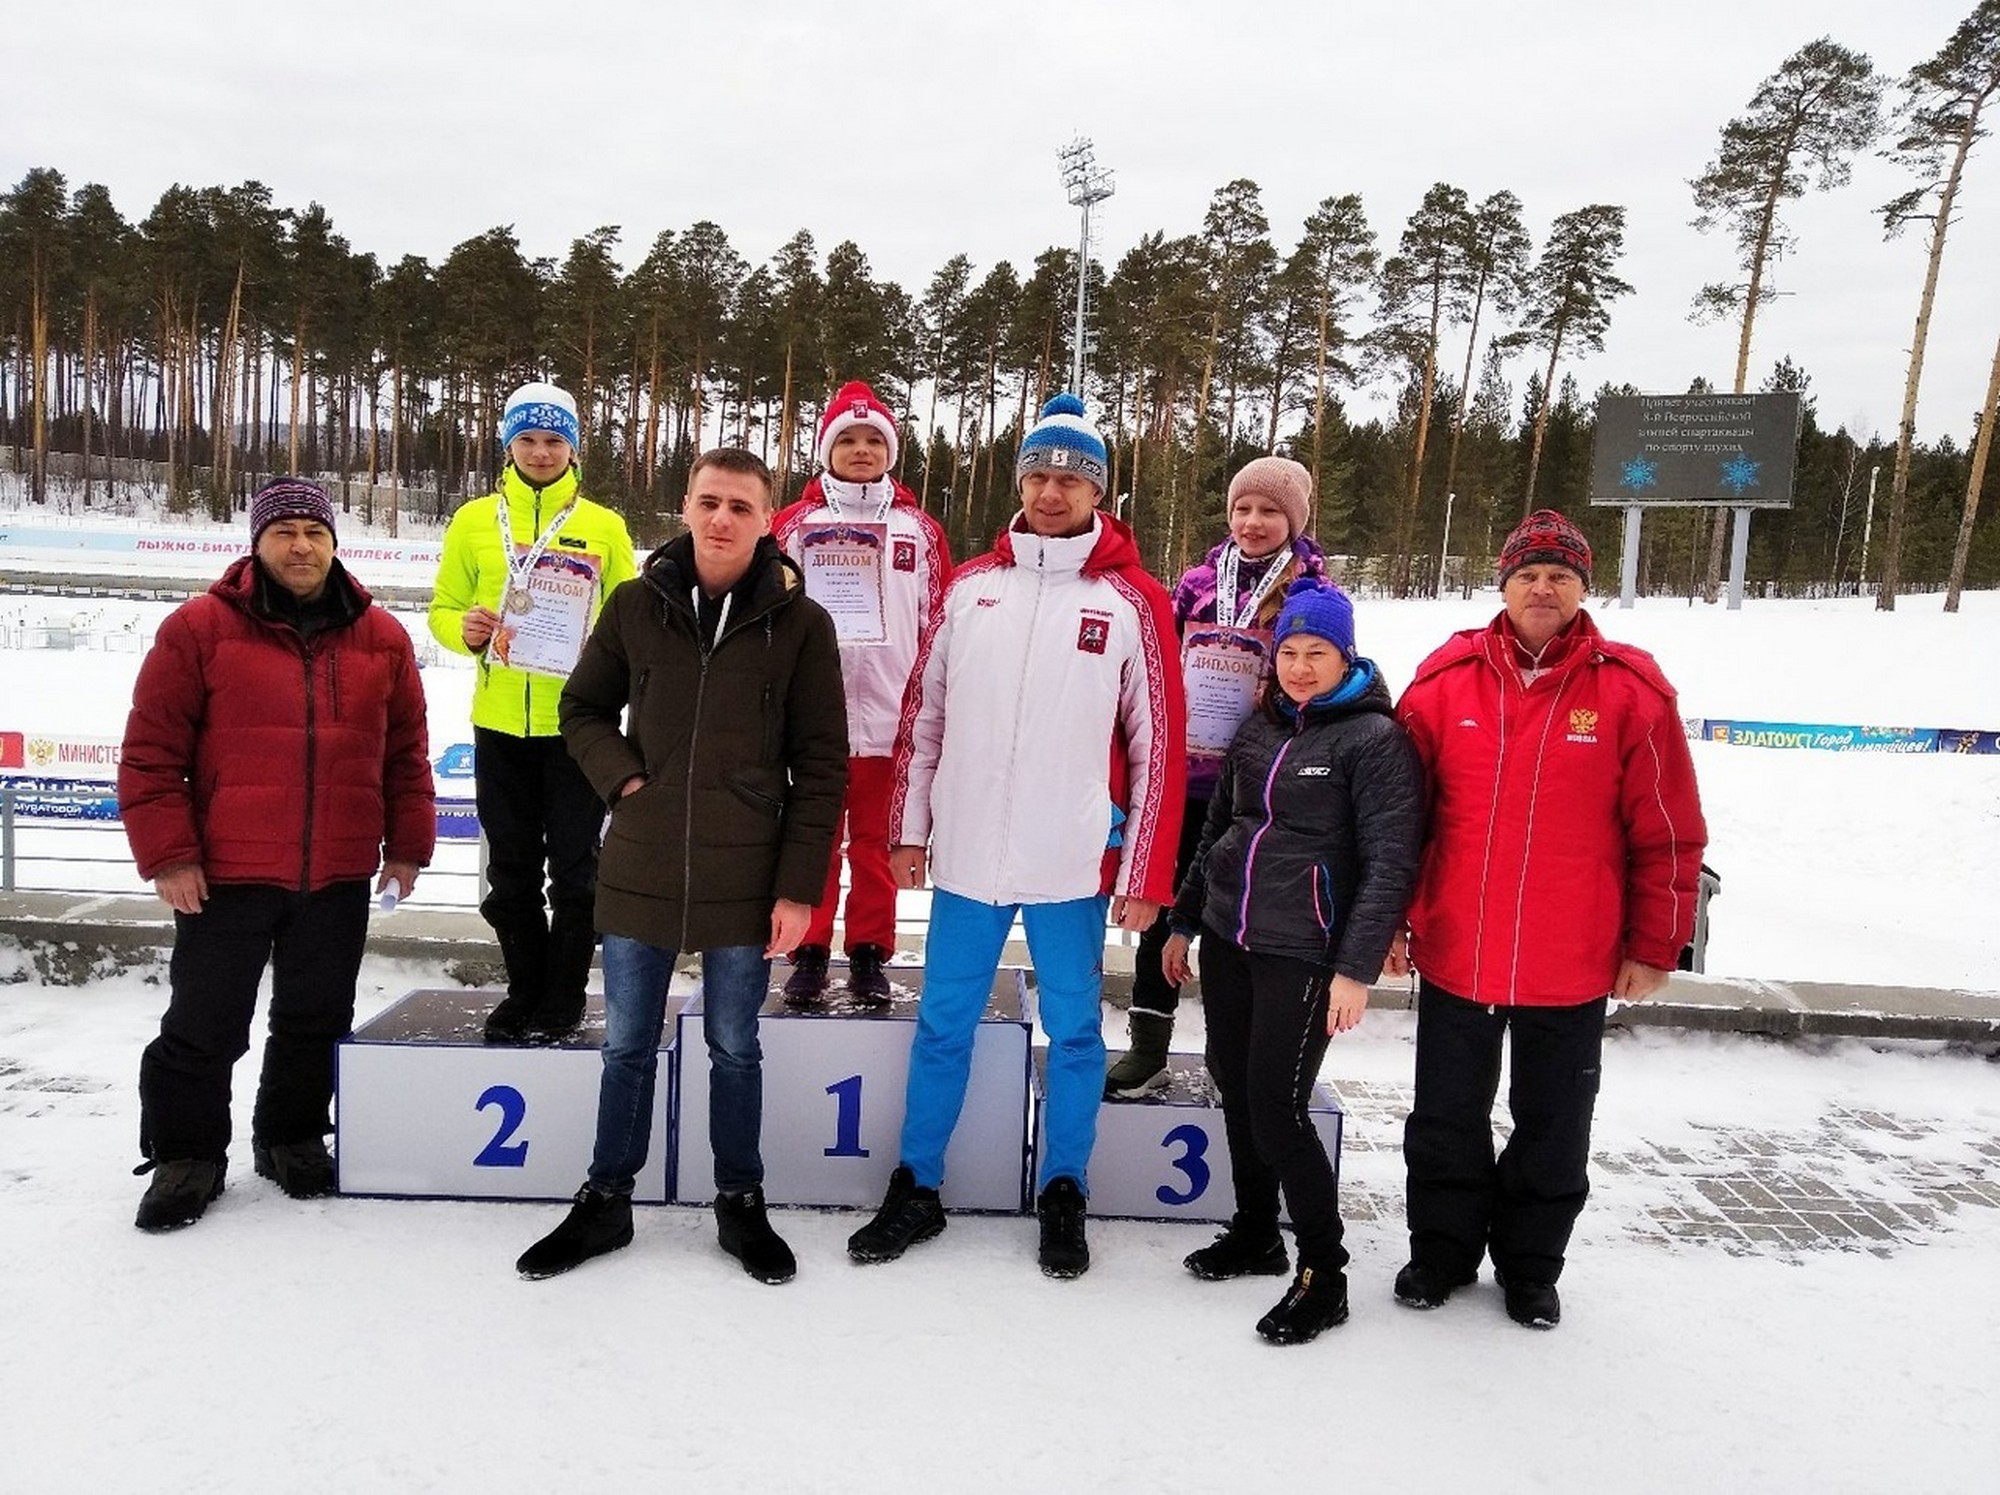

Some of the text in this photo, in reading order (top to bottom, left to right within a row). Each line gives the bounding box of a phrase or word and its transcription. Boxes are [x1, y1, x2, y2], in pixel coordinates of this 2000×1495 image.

[1641, 397, 1681, 409] Привет
[1664, 411, 1752, 424] Всероссийской
[1638, 426, 1755, 439] зимней спартакиады
[1645, 444, 1743, 455] по спорту глухих
[337, 548, 402, 561] МПЛЕКС
[812, 553, 872, 568] ДИПЛОМ
[1192, 655, 1254, 675] ДИПЛОМ
[1566, 733, 1598, 744] RUSSIA
[1732, 729, 1812, 749] ЗЛАТОУСТ
[1812, 730, 1854, 748] Город
[824, 1074, 869, 1158] 1
[473, 1084, 529, 1168] 2
[1156, 1123, 1211, 1206] 3
